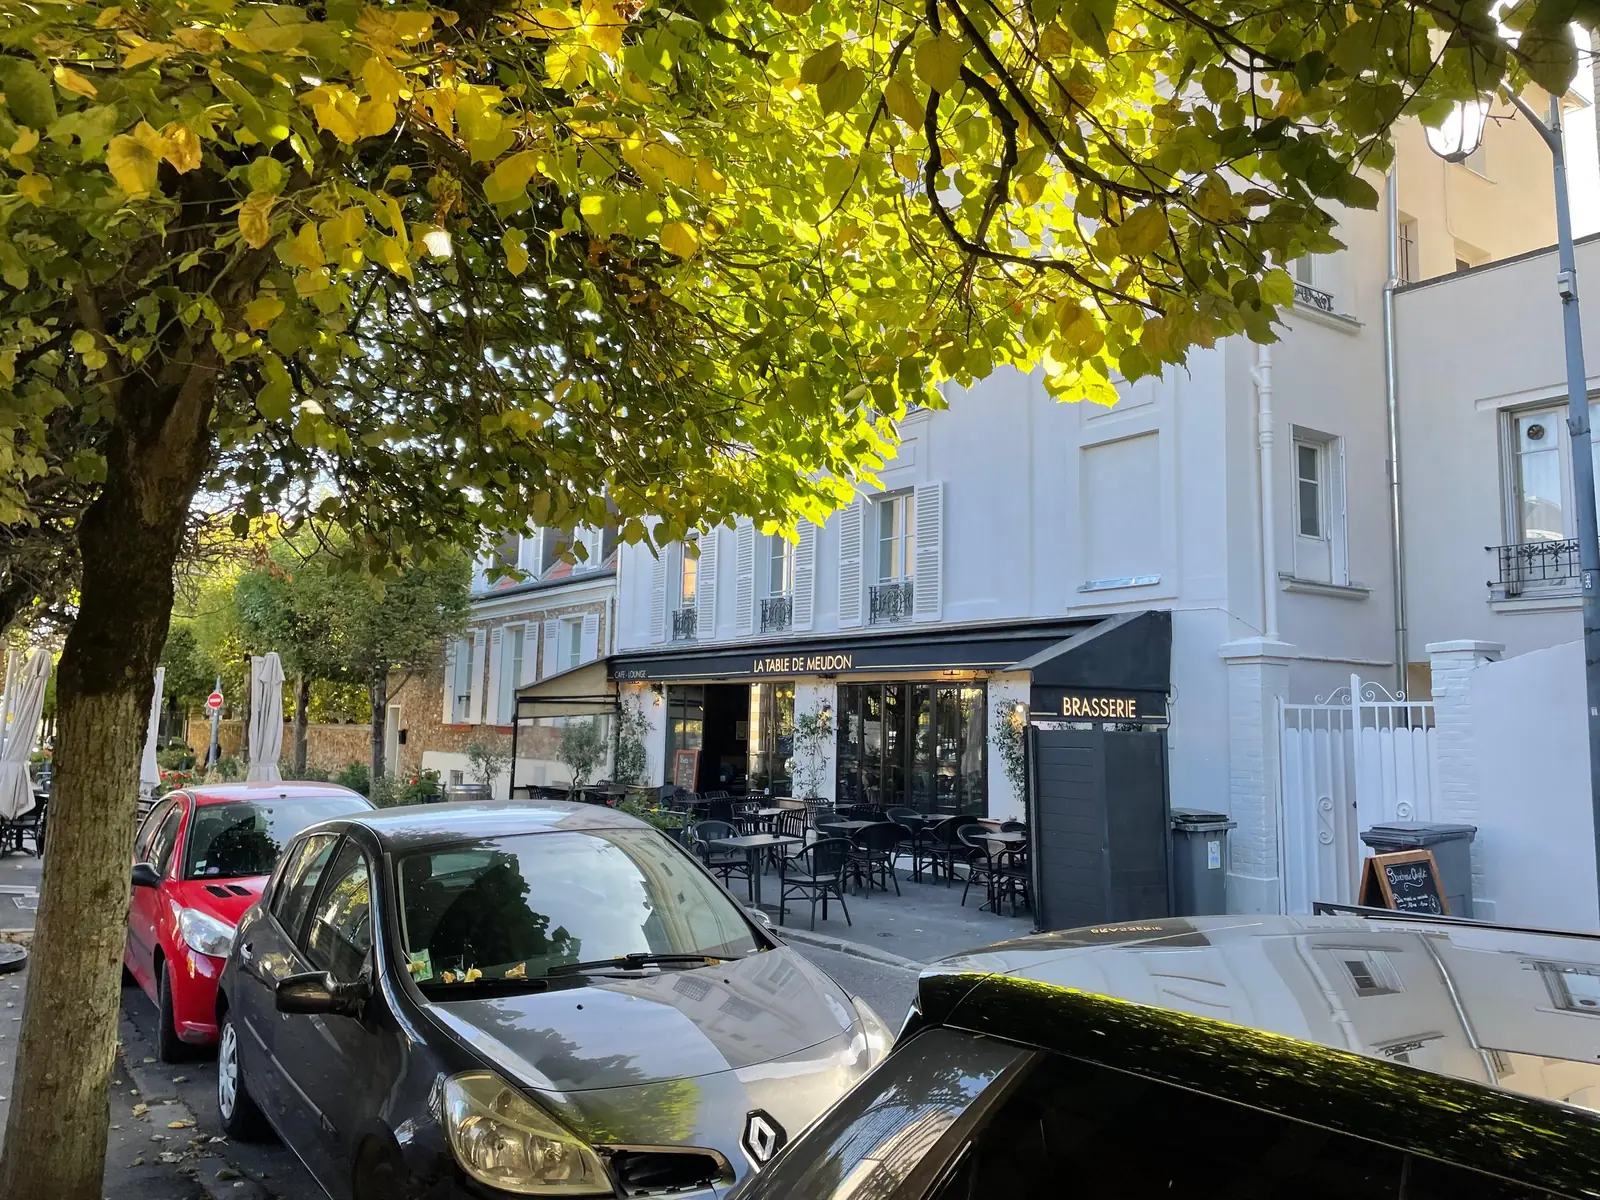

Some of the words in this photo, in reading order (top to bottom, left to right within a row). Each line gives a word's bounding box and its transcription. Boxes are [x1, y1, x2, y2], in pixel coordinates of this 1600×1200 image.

[753, 659, 764, 673] LA
[765, 657, 790, 672] TABLE
[792, 657, 804, 671] DE
[806, 654, 852, 671] MEUDON
[627, 669, 646, 679] LOUNGE
[1063, 696, 1136, 718] BRASSERIE
